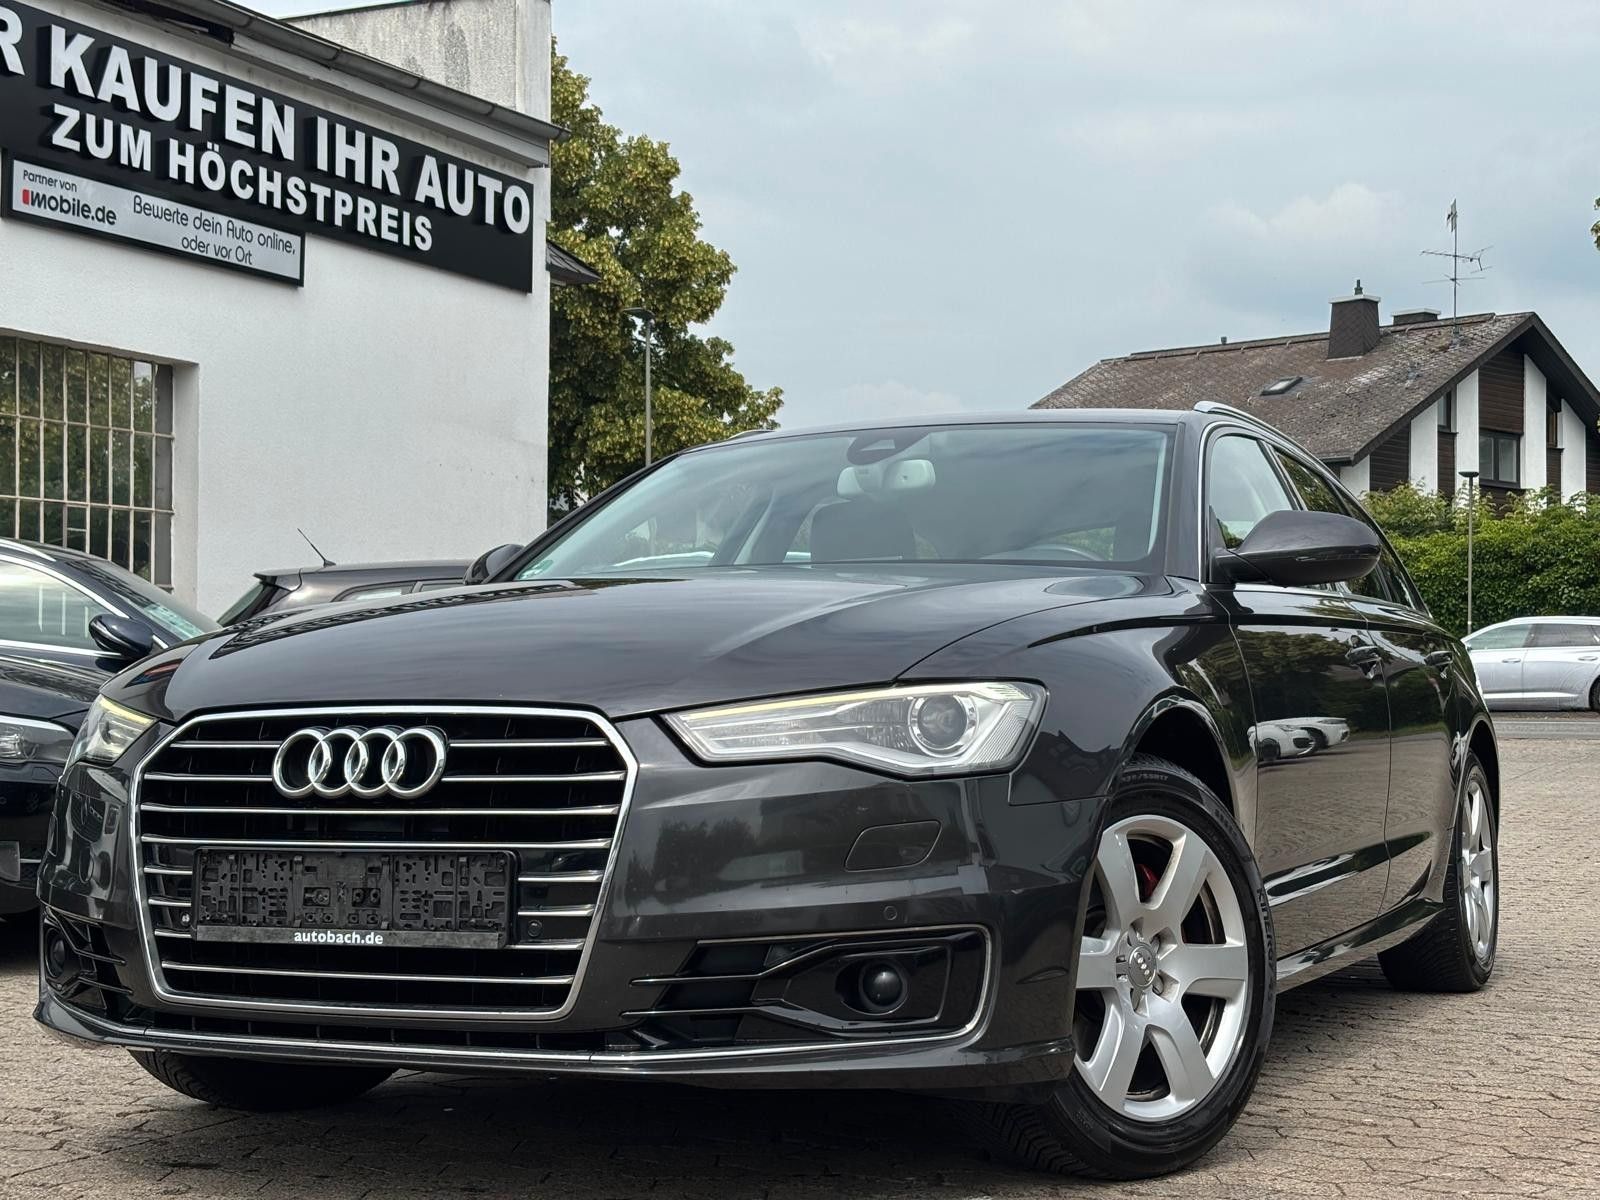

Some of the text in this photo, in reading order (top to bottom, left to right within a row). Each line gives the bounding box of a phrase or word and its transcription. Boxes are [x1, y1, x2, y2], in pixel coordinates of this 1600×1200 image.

[50, 24, 295, 161] KAUFEN
[317, 116, 401, 196] IHR
[415, 154, 530, 235] AUTO
[23, 169, 78, 192] Partner von
[52, 103, 433, 251] ZUM HÖCHSTPREIS
[29, 189, 117, 226] mobile.de
[133, 195, 297, 255] Bewerte dein Auto online,
[181, 236, 253, 266] oder vor Ort
[293, 930, 384, 945] autobach.de
